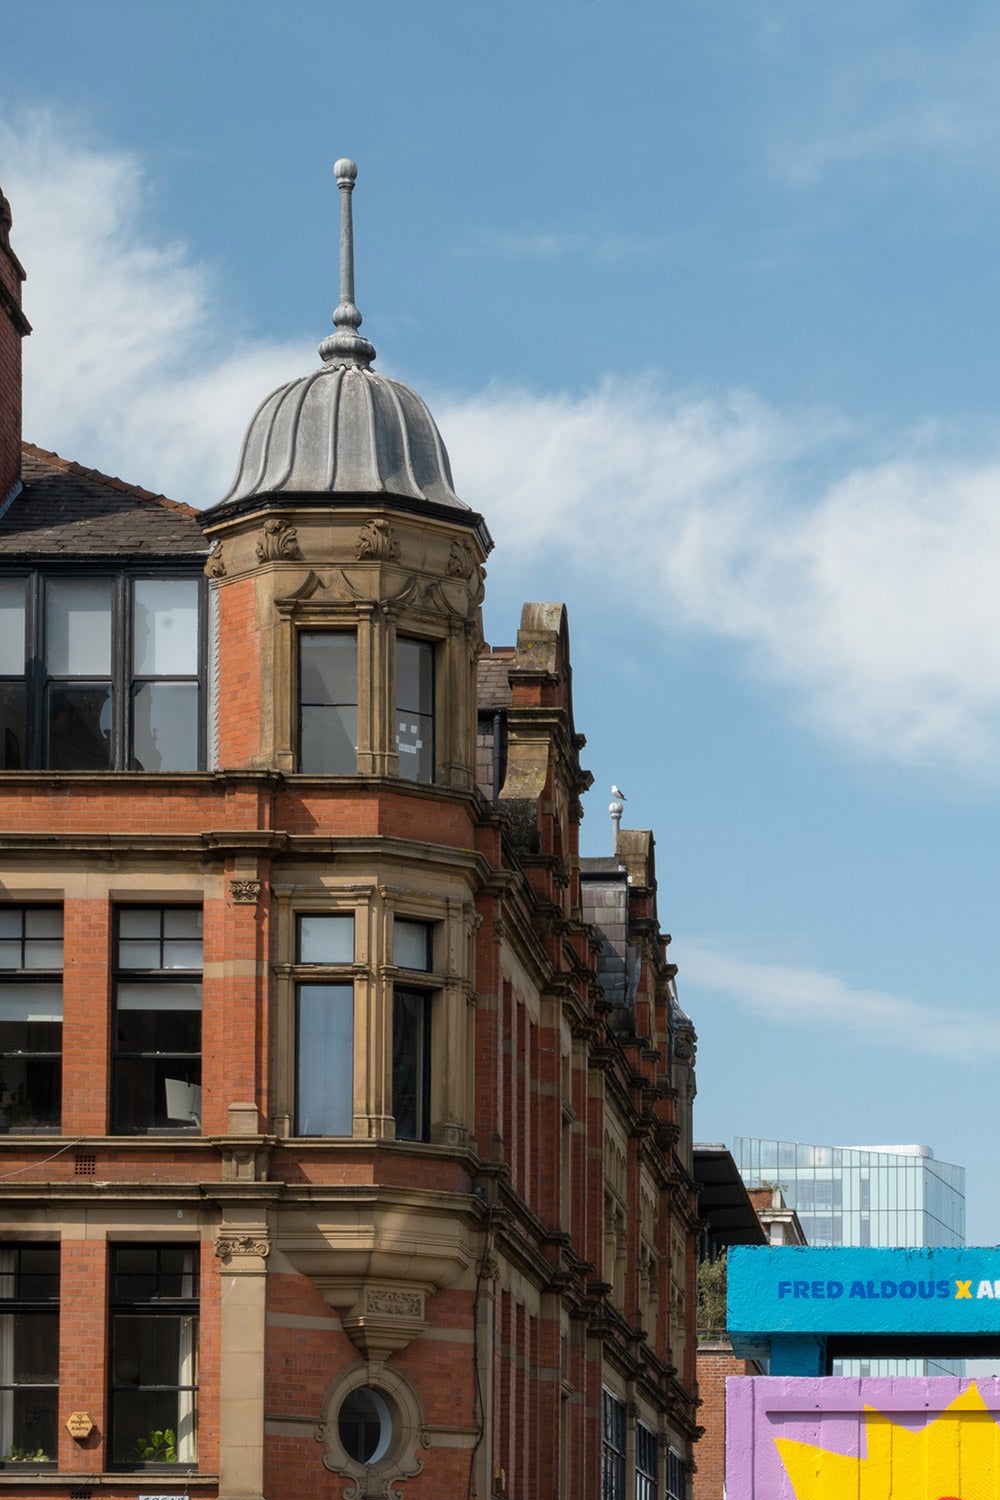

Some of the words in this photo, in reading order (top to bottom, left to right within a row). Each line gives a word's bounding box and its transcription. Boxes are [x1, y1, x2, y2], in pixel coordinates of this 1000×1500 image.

[778, 1281, 844, 1299] FRED
[850, 1280, 950, 1299] ALDOUS
[954, 1280, 972, 1299] X
